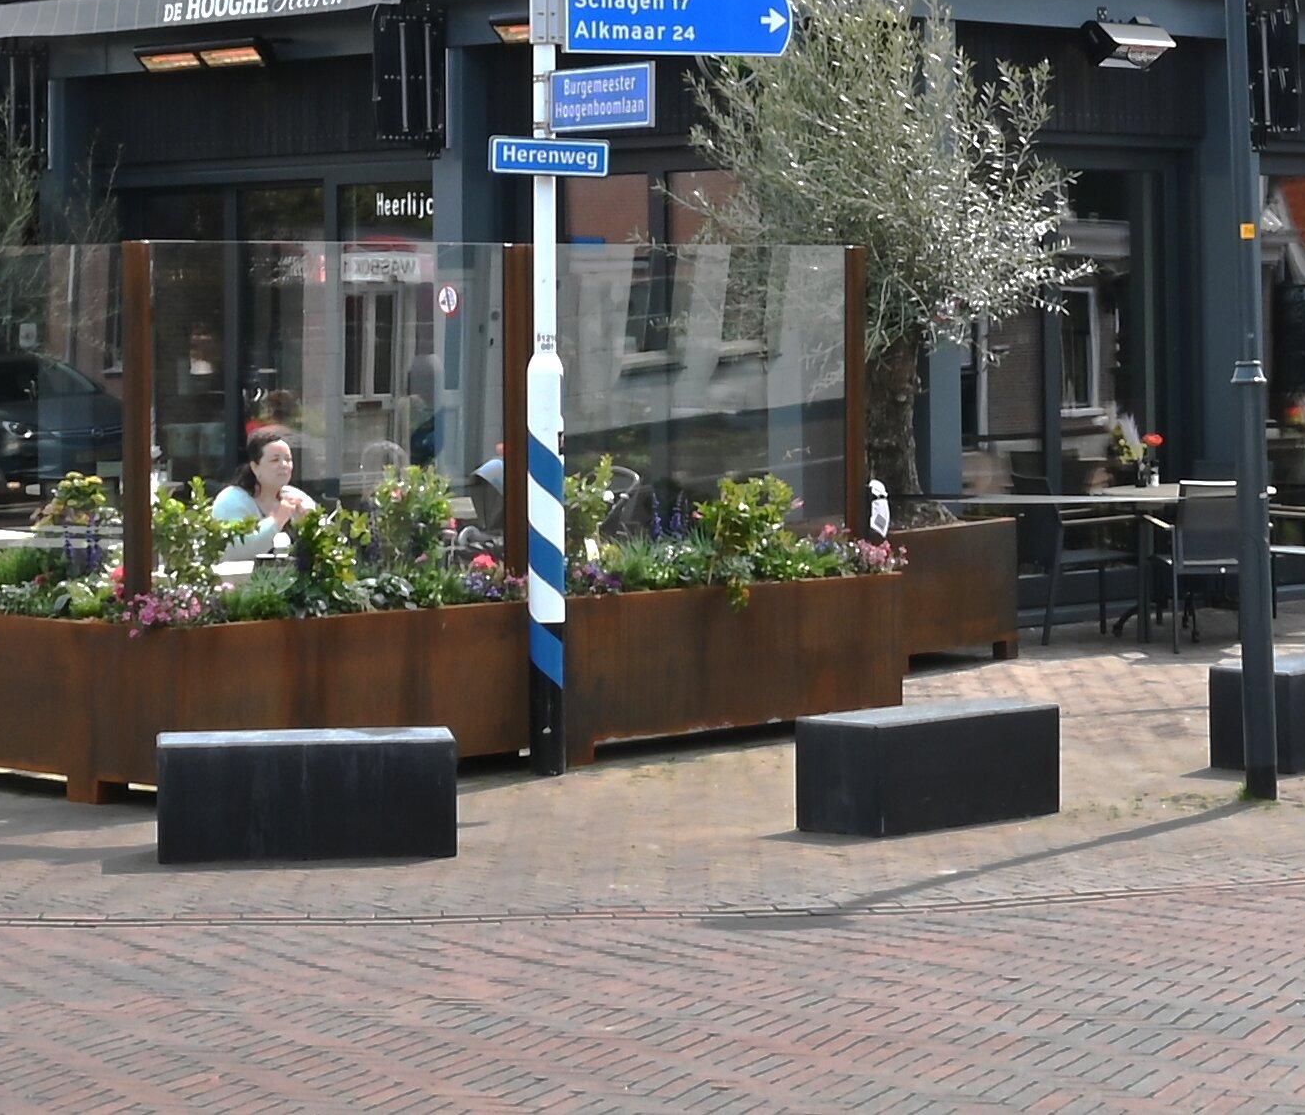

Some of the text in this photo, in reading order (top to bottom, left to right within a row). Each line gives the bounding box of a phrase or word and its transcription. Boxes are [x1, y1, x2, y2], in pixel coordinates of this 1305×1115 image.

[164, 2, 183, 22] DE
[574, 20, 695, 41] Alkmaar 24
[564, 76, 636, 98] Burgemeester
[555, 97, 644, 121] Hoogenboomlaan
[502, 145, 598, 169] Herenweg
